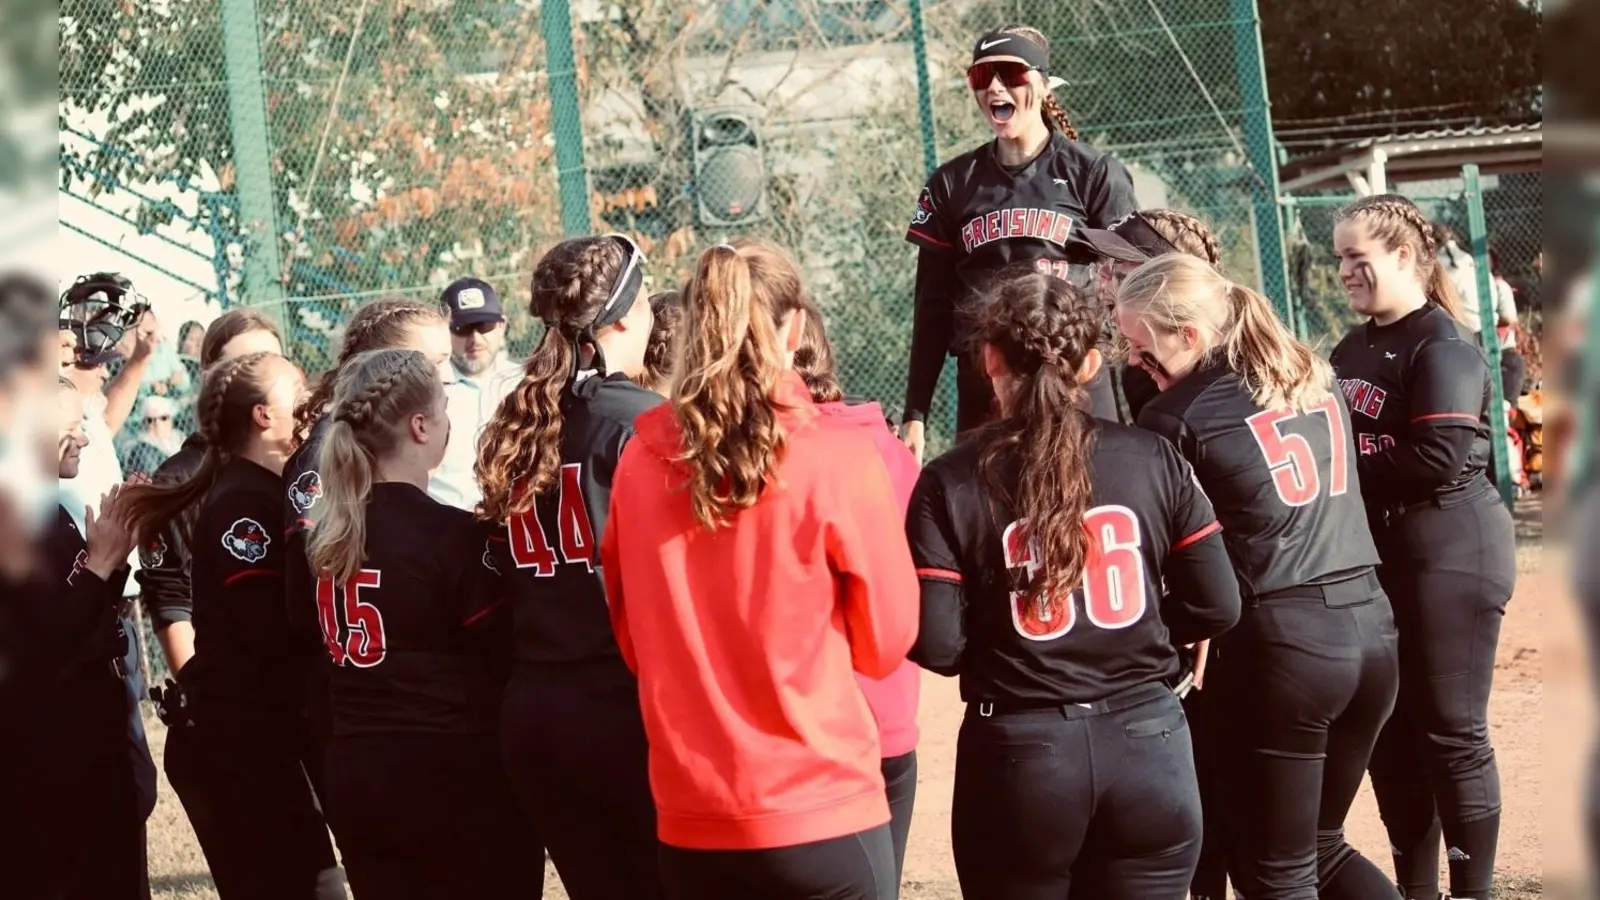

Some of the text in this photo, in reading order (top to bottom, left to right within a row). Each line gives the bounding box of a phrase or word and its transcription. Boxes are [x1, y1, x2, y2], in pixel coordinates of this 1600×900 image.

[962, 208, 1073, 254] FREISING
[1244, 393, 1347, 507] 57
[1337, 378, 1387, 419] ING
[507, 463, 596, 577] 44
[1002, 504, 1146, 641] 36
[316, 566, 387, 668] 45
